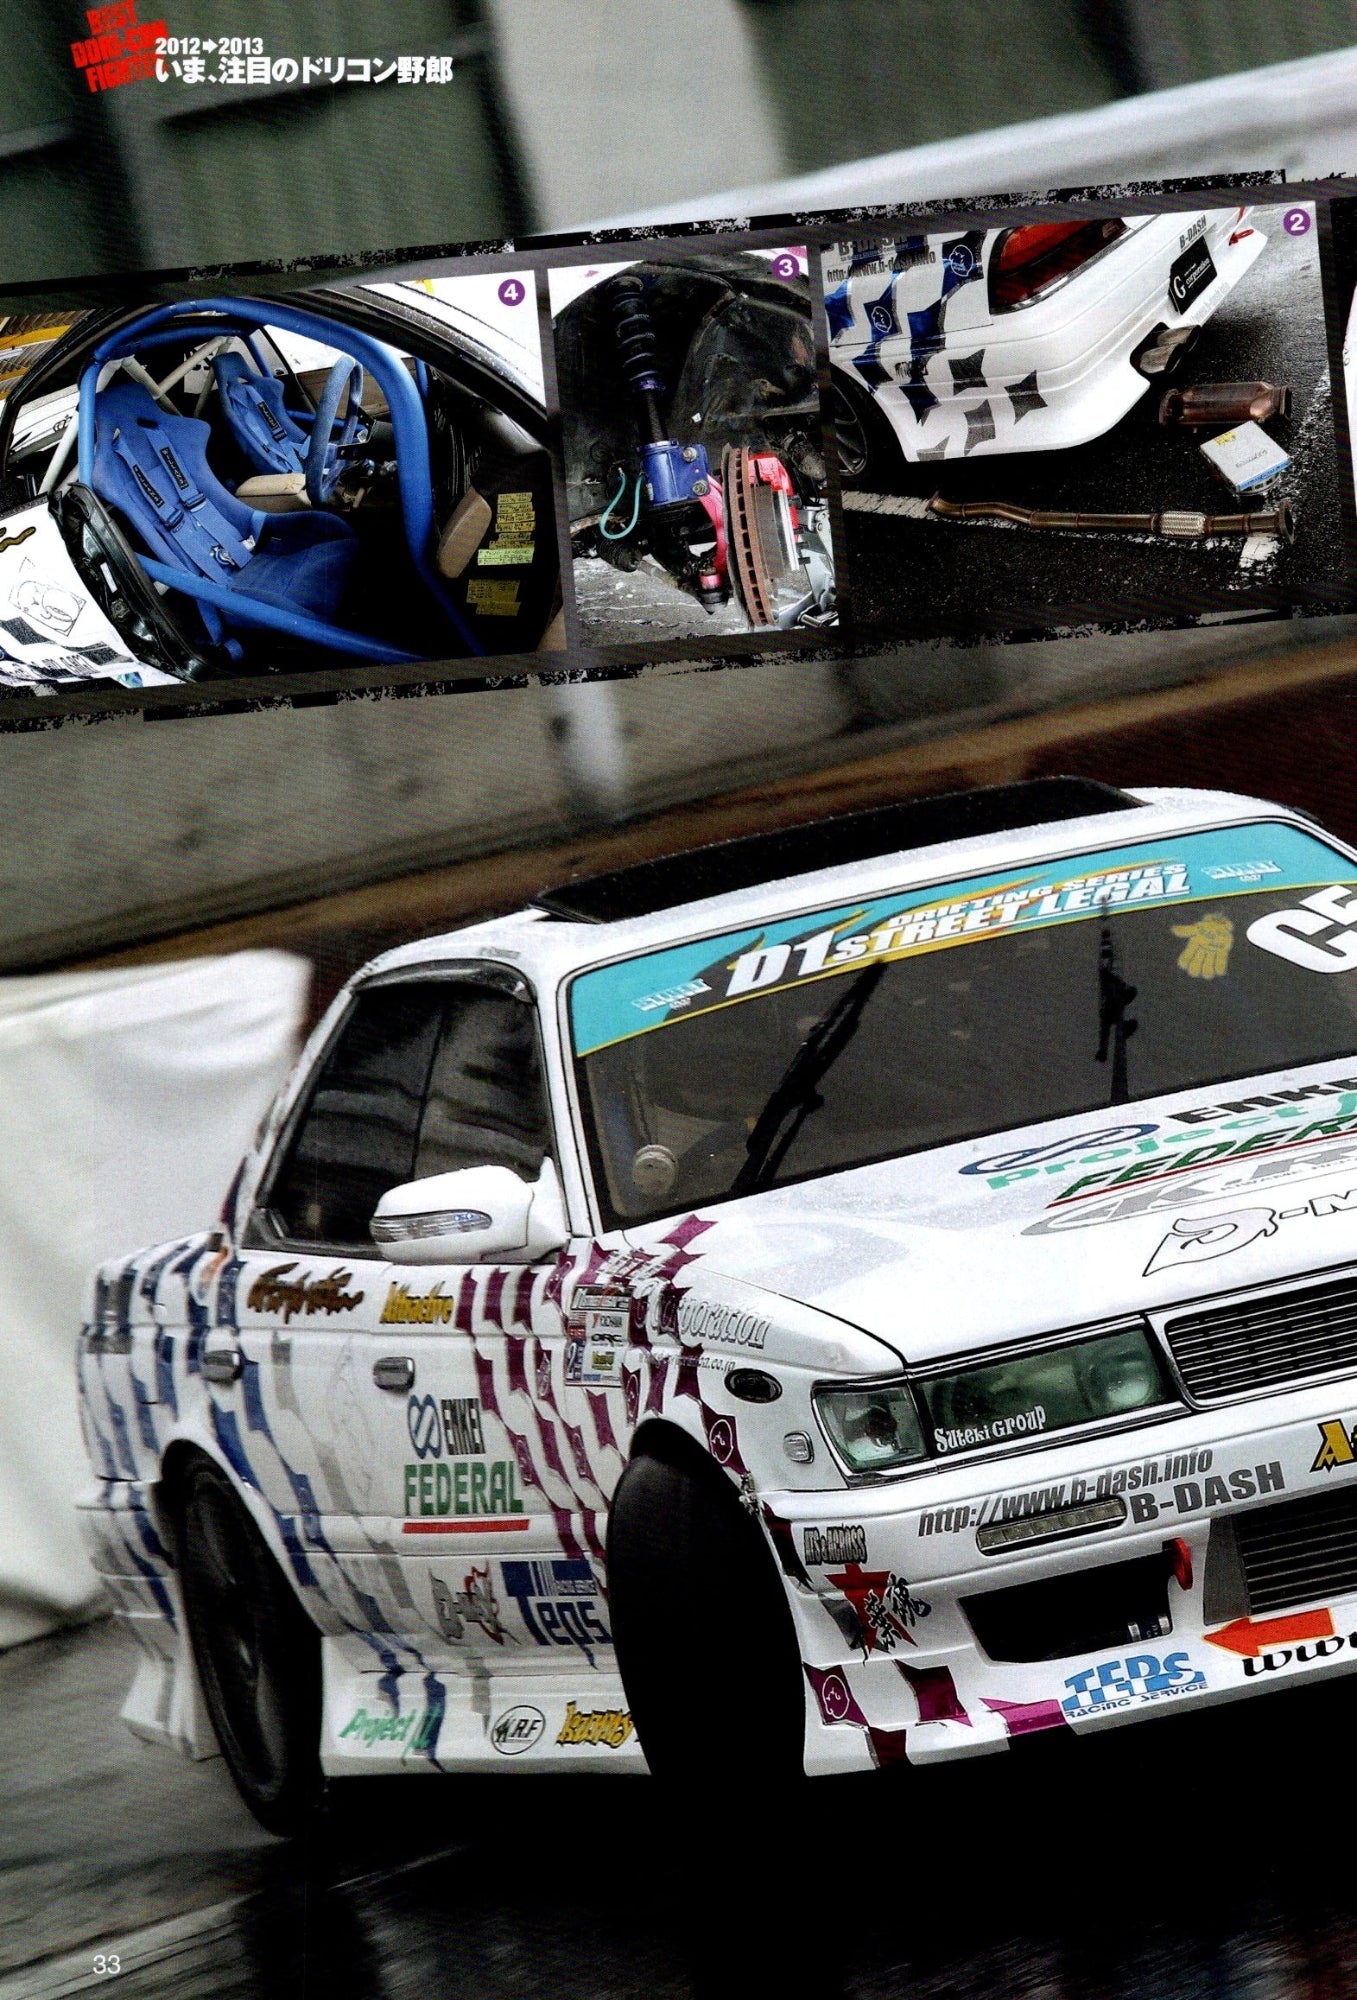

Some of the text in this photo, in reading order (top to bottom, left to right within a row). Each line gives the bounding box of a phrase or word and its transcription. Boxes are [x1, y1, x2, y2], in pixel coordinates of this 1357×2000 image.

[886, 884, 1056, 928] DRIFTING
[1057, 863, 1188, 894] SERIES
[1036, 872, 1193, 916] LEGAL
[441, 1397, 486, 1456] ENKEI
[404, 1460, 525, 1517] FEDERAL
[1132, 1460, 1287, 1524] B-DASH
